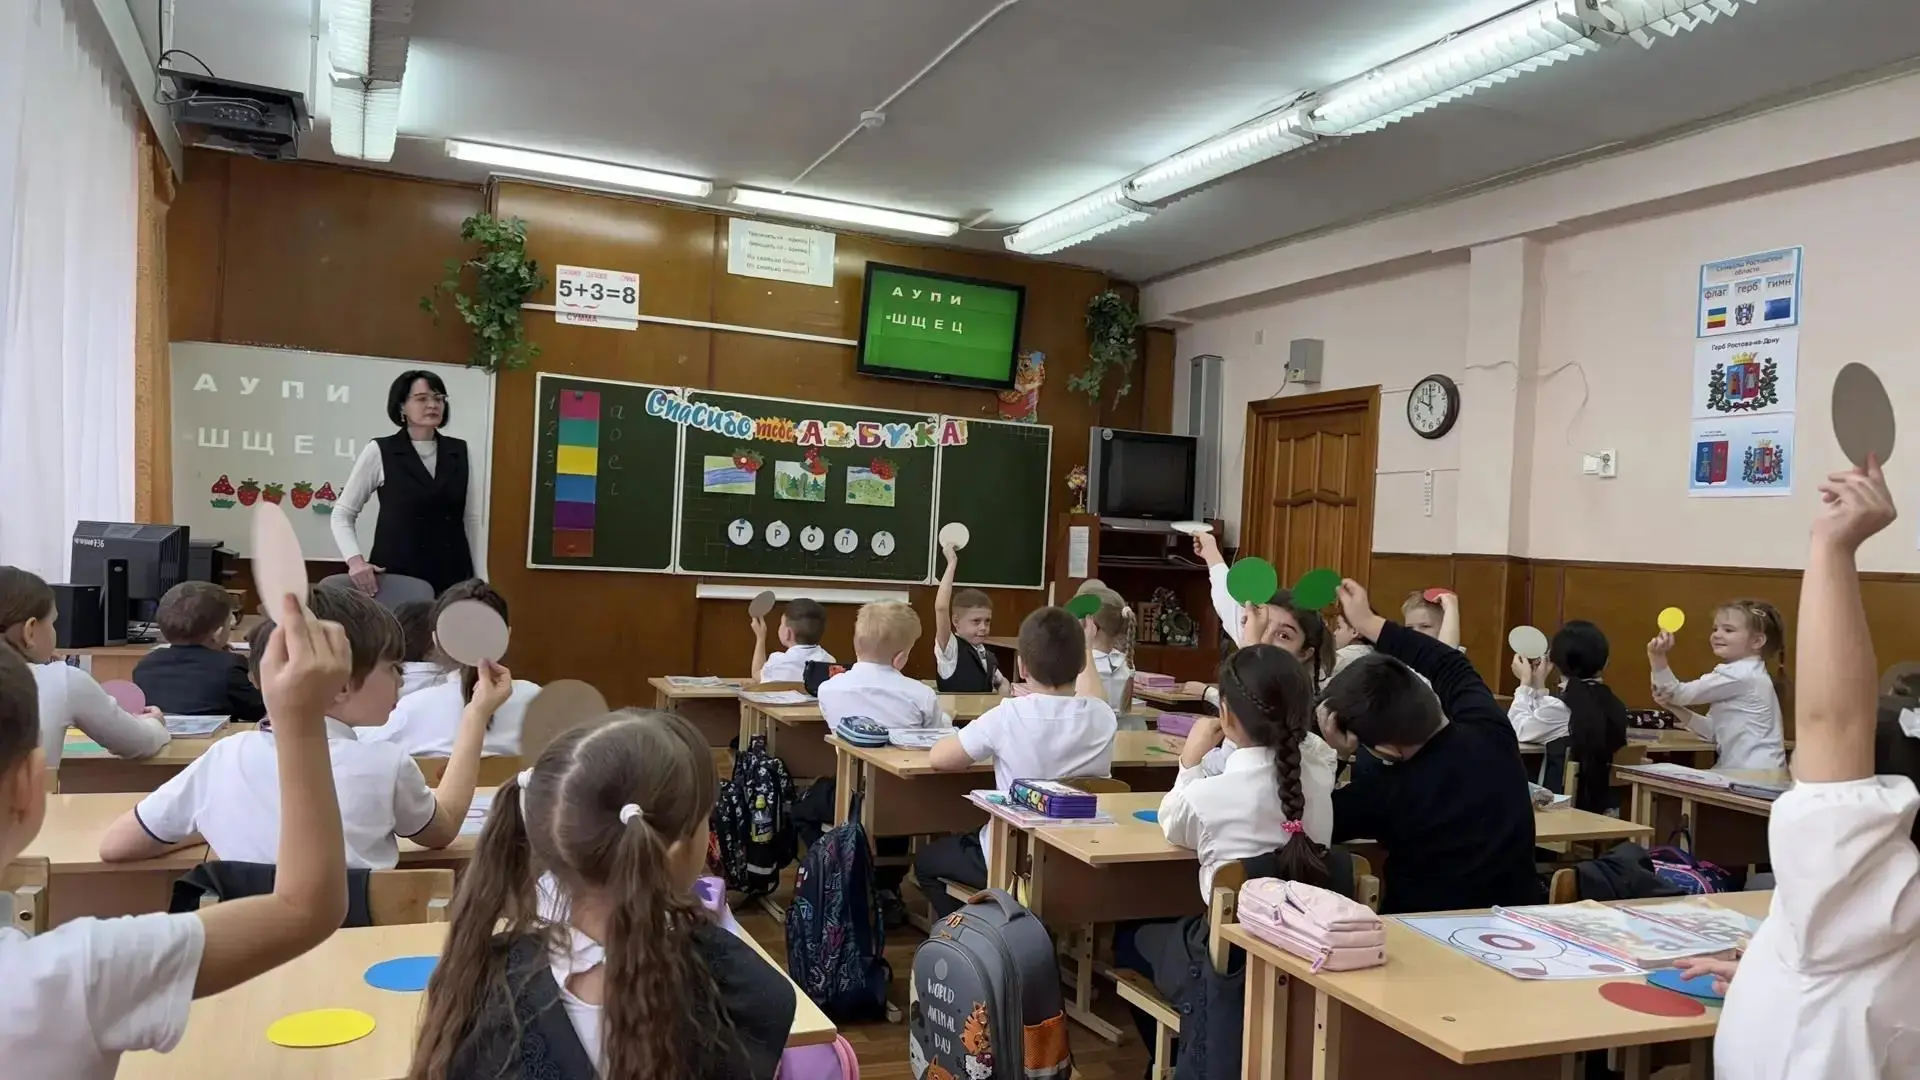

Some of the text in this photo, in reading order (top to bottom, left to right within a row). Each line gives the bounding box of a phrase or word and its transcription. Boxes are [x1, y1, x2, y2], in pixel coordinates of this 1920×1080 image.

[559, 279, 636, 304] 5+3=8
[892, 287, 962, 306] А У П И
[1737, 281, 1759, 294] герб
[1767, 278, 1792, 289] гимн
[892, 313, 963, 335] Ш Щ Е Ц
[1711, 342, 1726, 351] Герб
[193, 373, 349, 403] А У П И
[647, 389, 751, 437] Спасибо
[198, 427, 356, 461] Ш Щ Е Ц
[928, 978, 955, 1004] WORLD
[928, 1004, 955, 1033] ANIMAL
[934, 1032, 951, 1055] DAY
